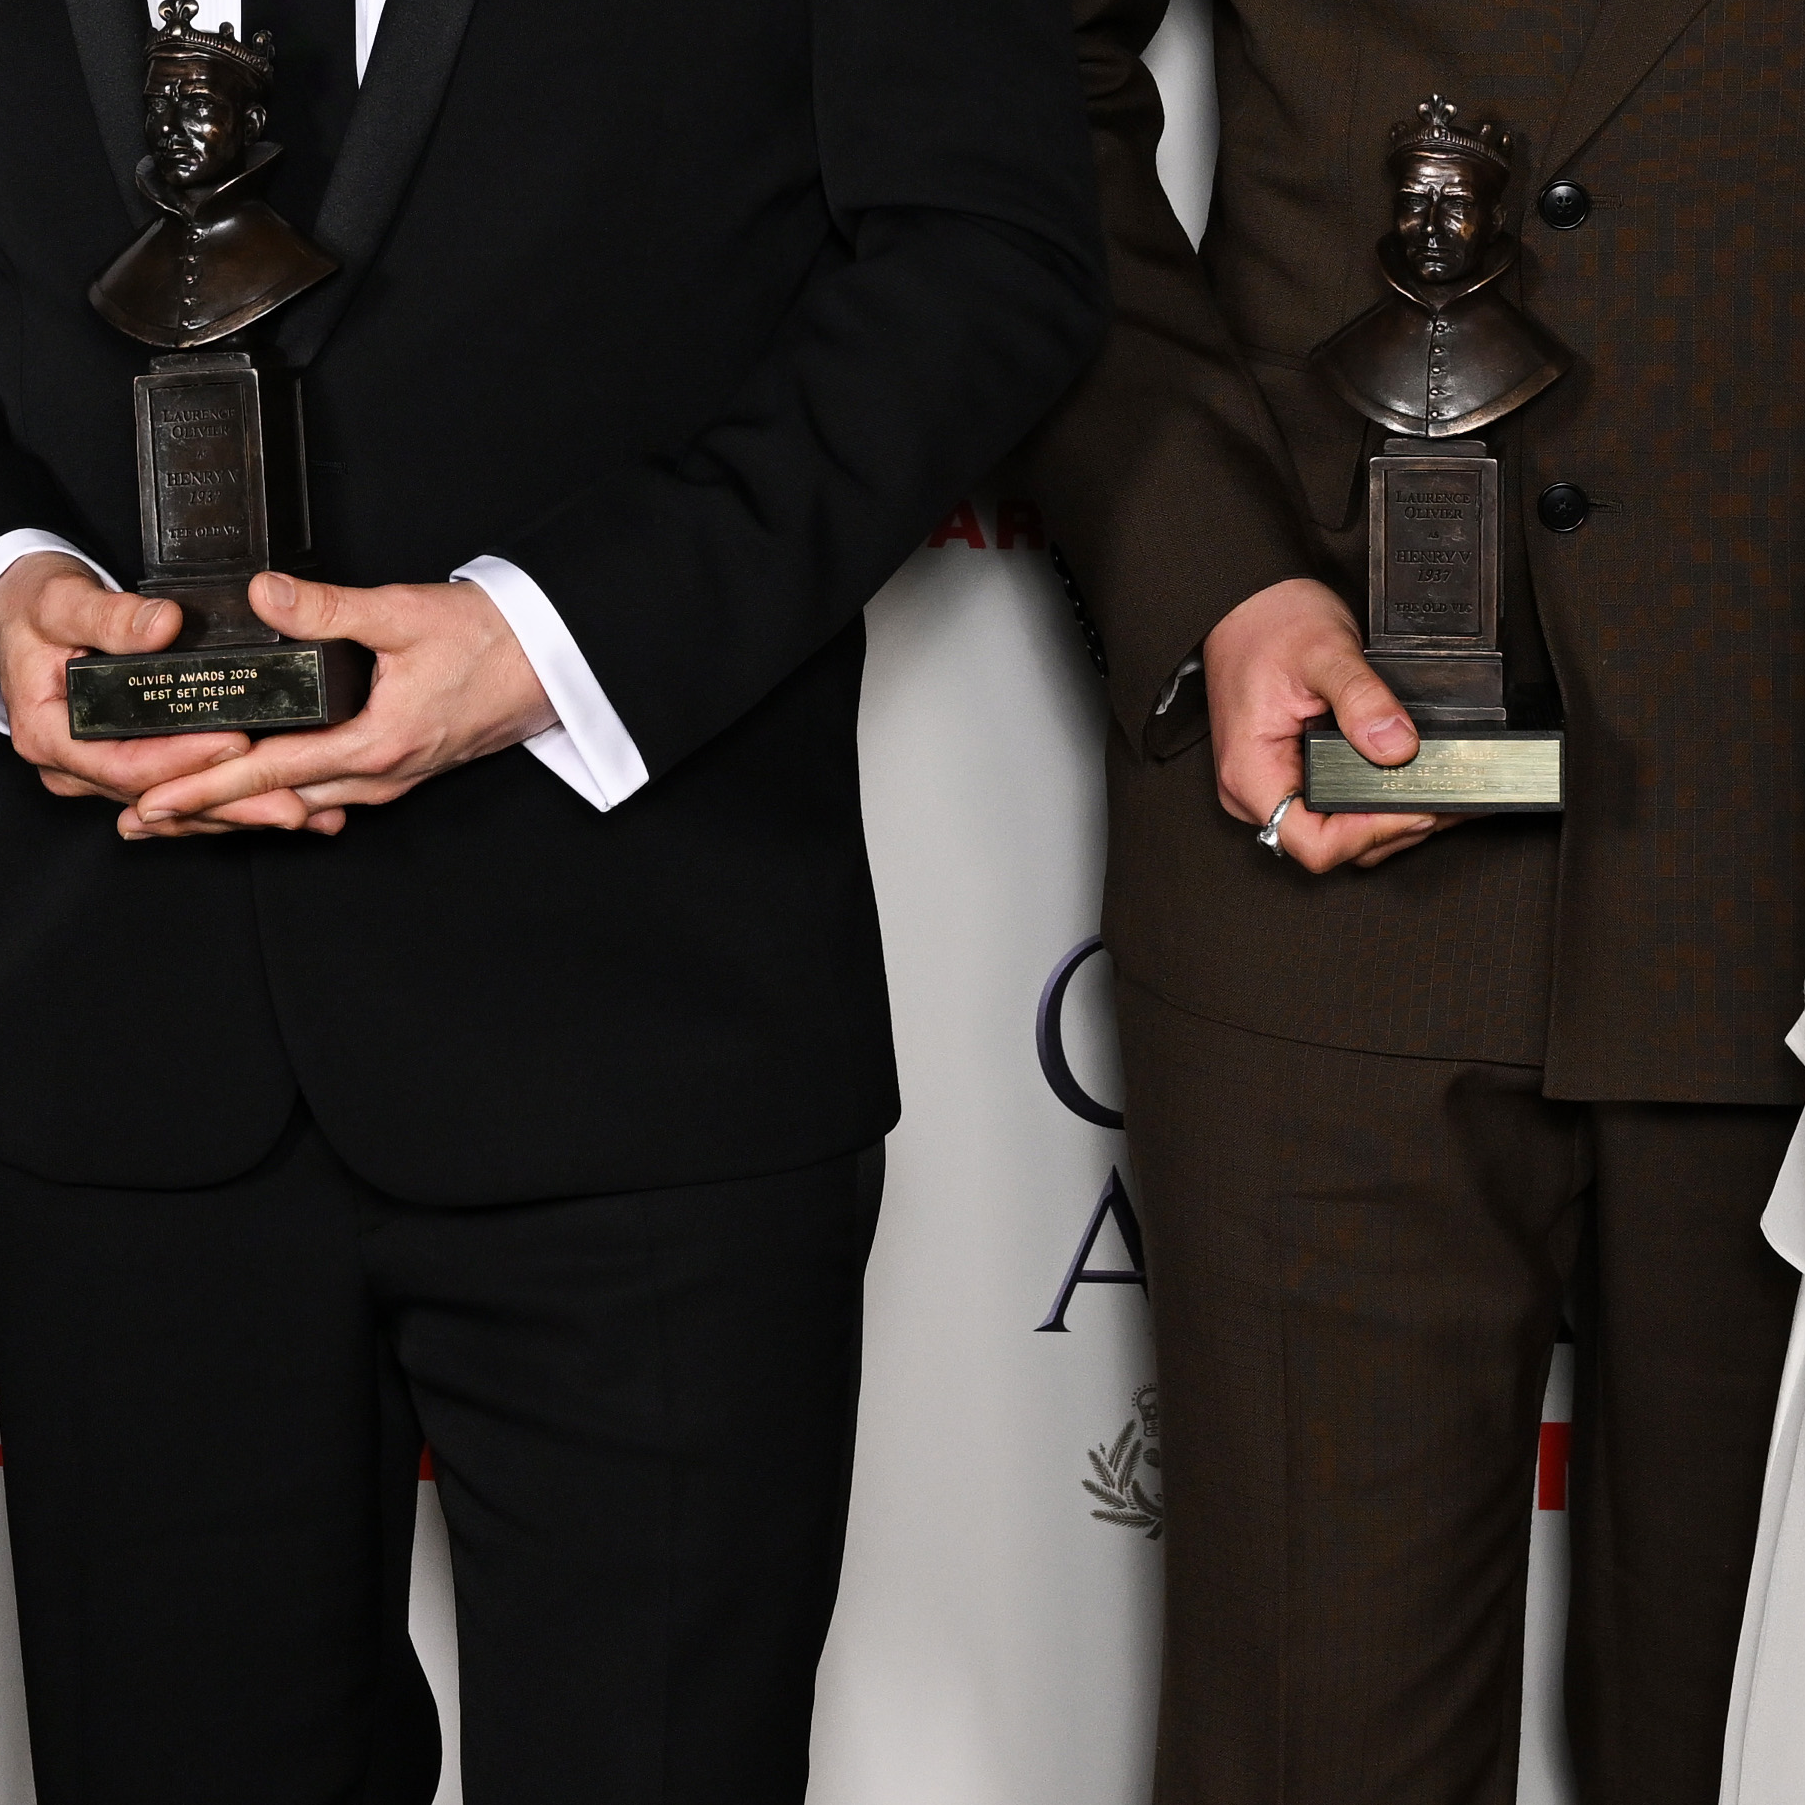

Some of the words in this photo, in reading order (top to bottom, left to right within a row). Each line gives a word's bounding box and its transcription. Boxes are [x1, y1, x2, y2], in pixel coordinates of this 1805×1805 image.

[165, 470, 223, 488] HENRY
[1395, 491, 1472, 505] LAURENCE
[1403, 506, 1465, 521] OLIVIER
[1395, 550, 1455, 565] HENRY
[1457, 549, 1473, 565] V
[1416, 568, 1453, 583] 1937
[1394, 602, 1419, 613] THE
[1422, 602, 1448, 614] OLD
[1450, 602, 1474, 614] VIC
[128, 674, 174, 686] OLIVIER
[179, 671, 225, 683] AWARDS
[229, 669, 258, 680] 2026
[143, 688, 172, 701] BEST
[176, 687, 198, 699] SET
[202, 684, 245, 697] DESIGN
[168, 703, 193, 714] TOM
[198, 701, 220, 711] PYE
